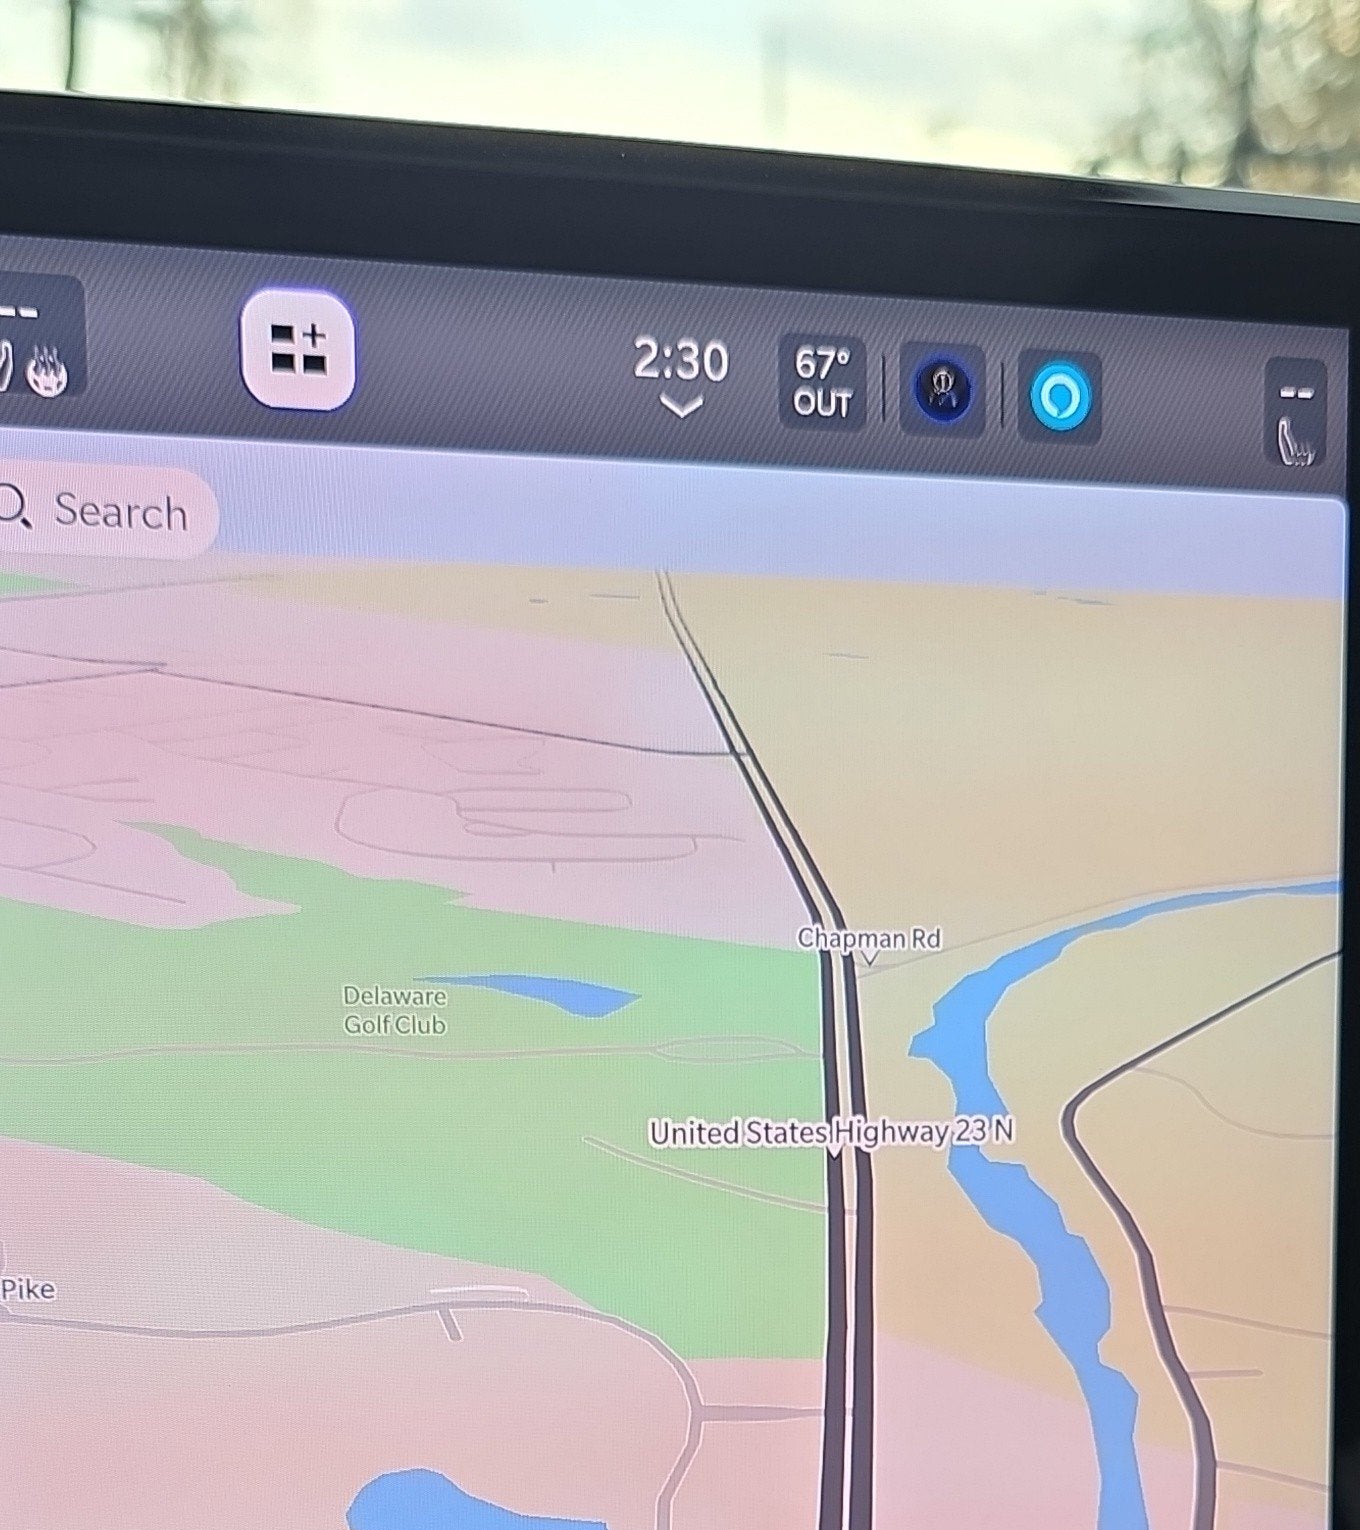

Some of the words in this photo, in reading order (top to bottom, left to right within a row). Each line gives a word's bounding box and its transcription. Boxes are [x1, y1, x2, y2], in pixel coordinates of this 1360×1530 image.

[634, 334, 729, 383] 2:30
[793, 388, 852, 419] OUT
[55, 491, 189, 532] Search
[798, 926, 906, 954] Chapman
[912, 927, 941, 949] Rd
[343, 985, 447, 1008] Delaware
[343, 1013, 392, 1036] Golf
[396, 1013, 447, 1036] Club
[651, 1119, 739, 1147] United
[746, 1119, 827, 1147] States
[833, 1119, 949, 1152] Highway
[955, 1120, 988, 1144] 23
[994, 1119, 1014, 1143] N
[1, 1278, 56, 1302] Pike
